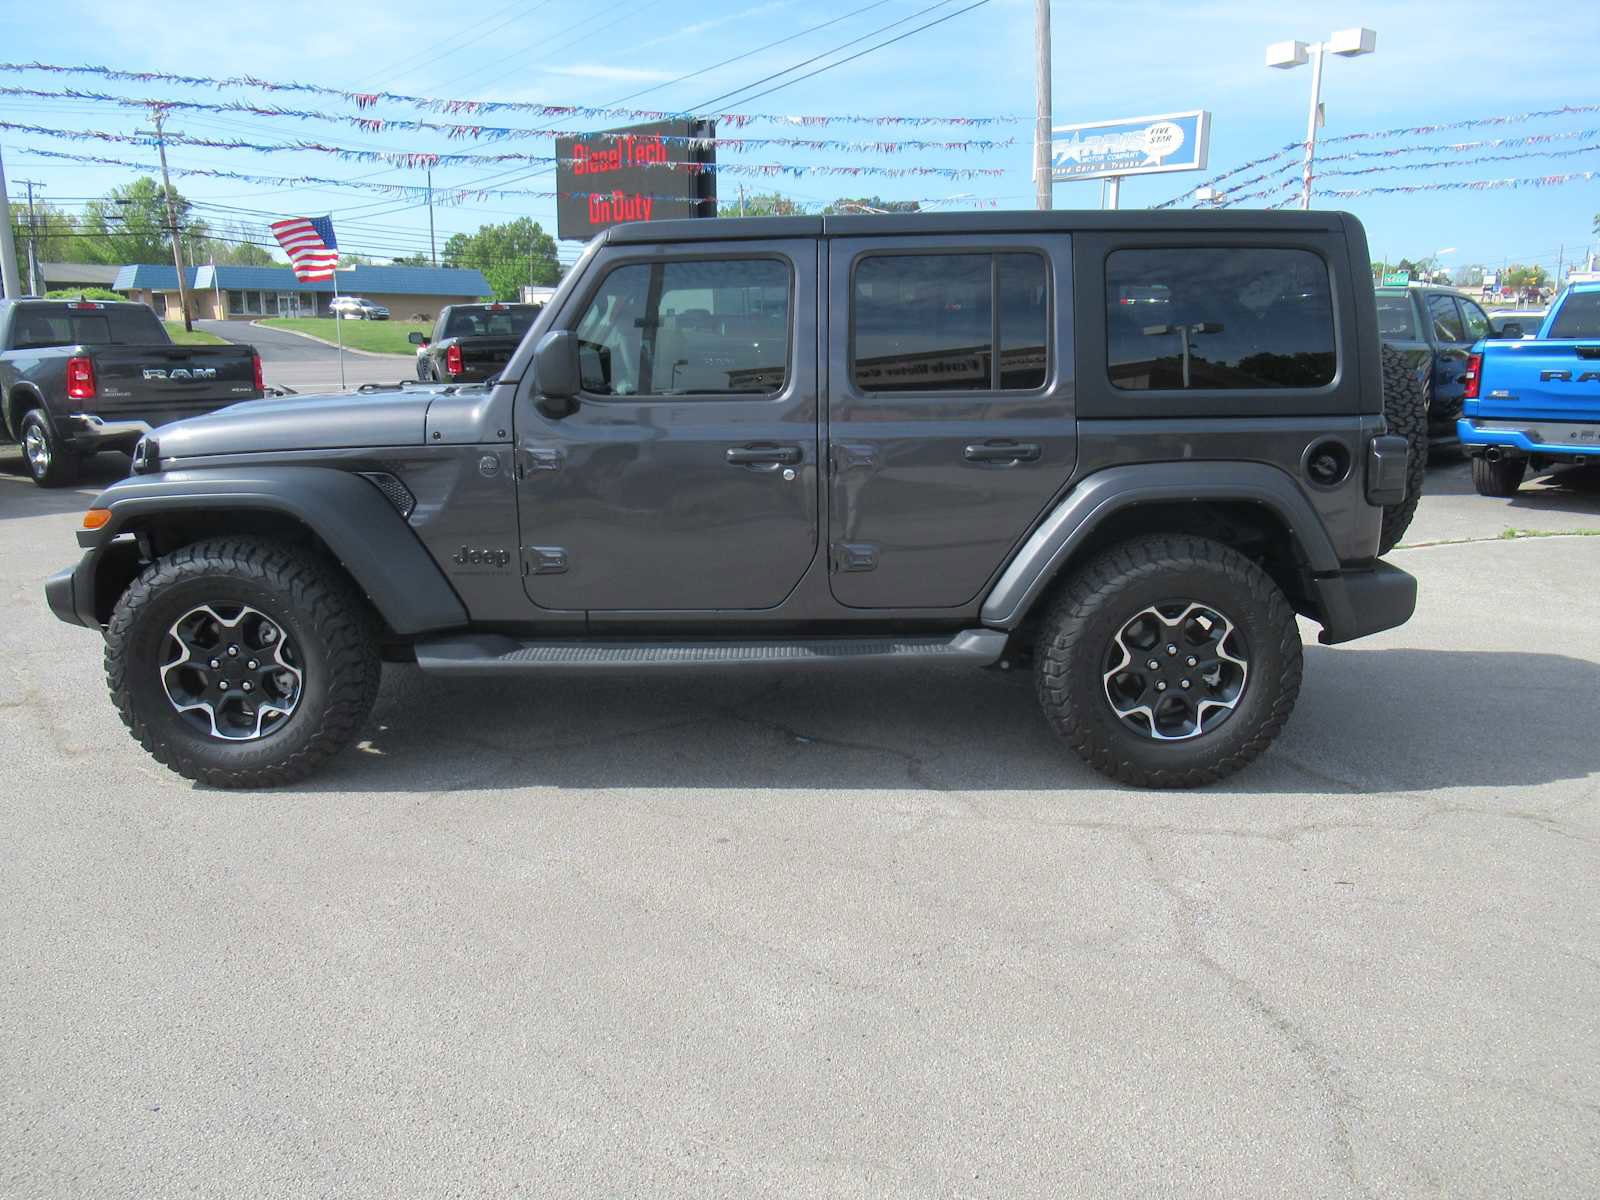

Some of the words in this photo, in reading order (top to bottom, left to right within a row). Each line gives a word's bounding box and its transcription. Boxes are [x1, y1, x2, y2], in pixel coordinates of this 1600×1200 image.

[1150, 127, 1169, 135] FIVE
[1150, 135, 1172, 144] STAR
[573, 140, 622, 175] Diesel
[626, 132, 667, 166] Tech
[589, 192, 610, 224] On
[613, 190, 653, 225] Duty
[142, 368, 217, 380] RAM
[453, 545, 510, 568] Jeep
